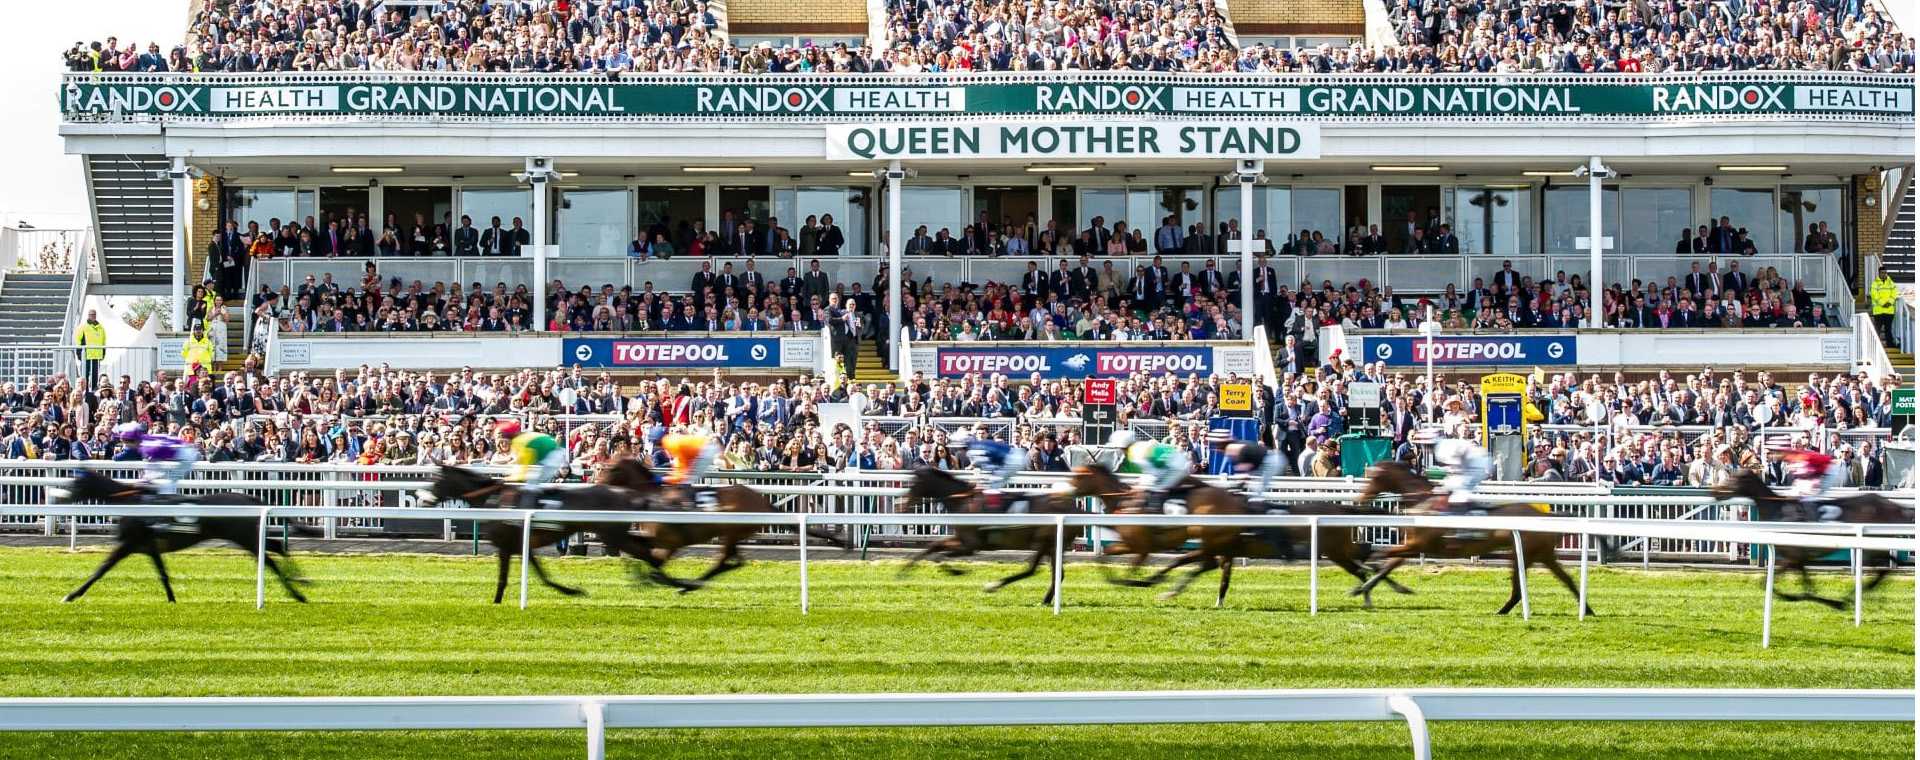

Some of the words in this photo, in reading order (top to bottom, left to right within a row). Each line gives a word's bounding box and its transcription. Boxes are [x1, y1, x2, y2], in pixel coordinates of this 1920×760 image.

[66, 86, 202, 111] RANDOX
[226, 90, 323, 108] HEALTH
[346, 86, 456, 111] GRAND
[464, 87, 625, 111] NATIONAL
[697, 87, 831, 112] RANDOX
[850, 91, 950, 108] HEALTH
[1036, 85, 1166, 111] RANDOX
[1186, 91, 1285, 108] HEALTH
[1307, 87, 1415, 112] GRAND
[1423, 87, 1580, 112] NATIONAL
[1653, 85, 1786, 111] RANDOX
[1809, 89, 1899, 108] HEALTH
[847, 126, 980, 159] QUEEN
[1000, 126, 1161, 153] MOTHER
[1179, 126, 1301, 154] STAND
[616, 344, 729, 361] TOTEPOOL
[1416, 343, 1526, 359] TOTEPOOL
[942, 354, 1051, 371] TOTEPOOL
[1100, 354, 1207, 371] TOTEPOOL
[1091, 381, 1110, 390] Andy
[1226, 390, 1246, 398] Terry
